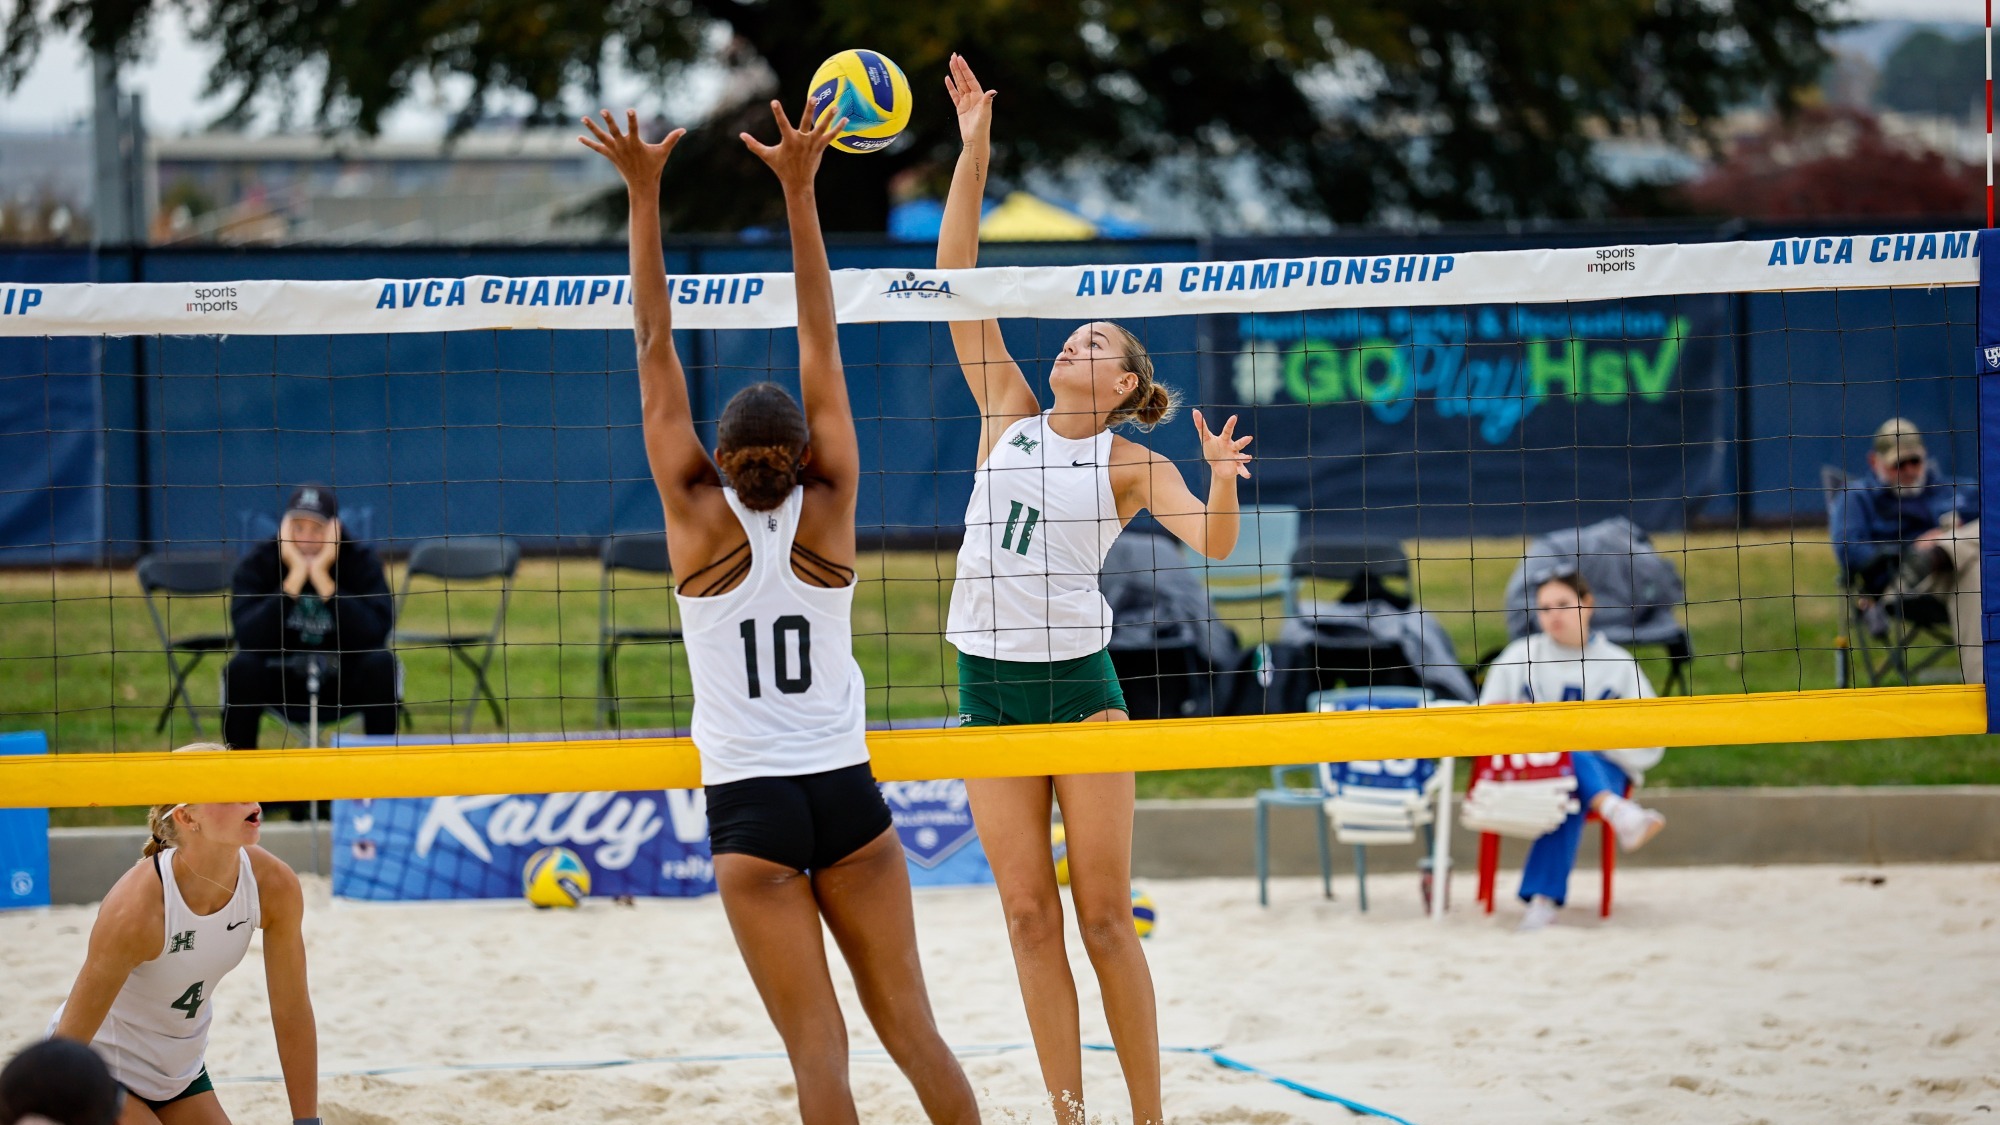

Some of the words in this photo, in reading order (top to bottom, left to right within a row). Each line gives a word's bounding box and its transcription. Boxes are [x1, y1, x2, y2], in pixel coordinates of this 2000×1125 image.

[1596, 248, 1635, 261] sports
[1768, 238, 1852, 266] AVCA
[1076, 268, 1163, 297] AVCA
[1179, 255, 1455, 293] CHAMPIONSHIP
[0, 288, 43, 315] IP
[195, 286, 237, 300] sports
[376, 280, 465, 309] AVCA
[480, 277, 764, 307] CHAMPISHIP
[1001, 499, 1040, 556] 11
[740, 615, 812, 698] 10
[171, 980, 205, 1019] 4
